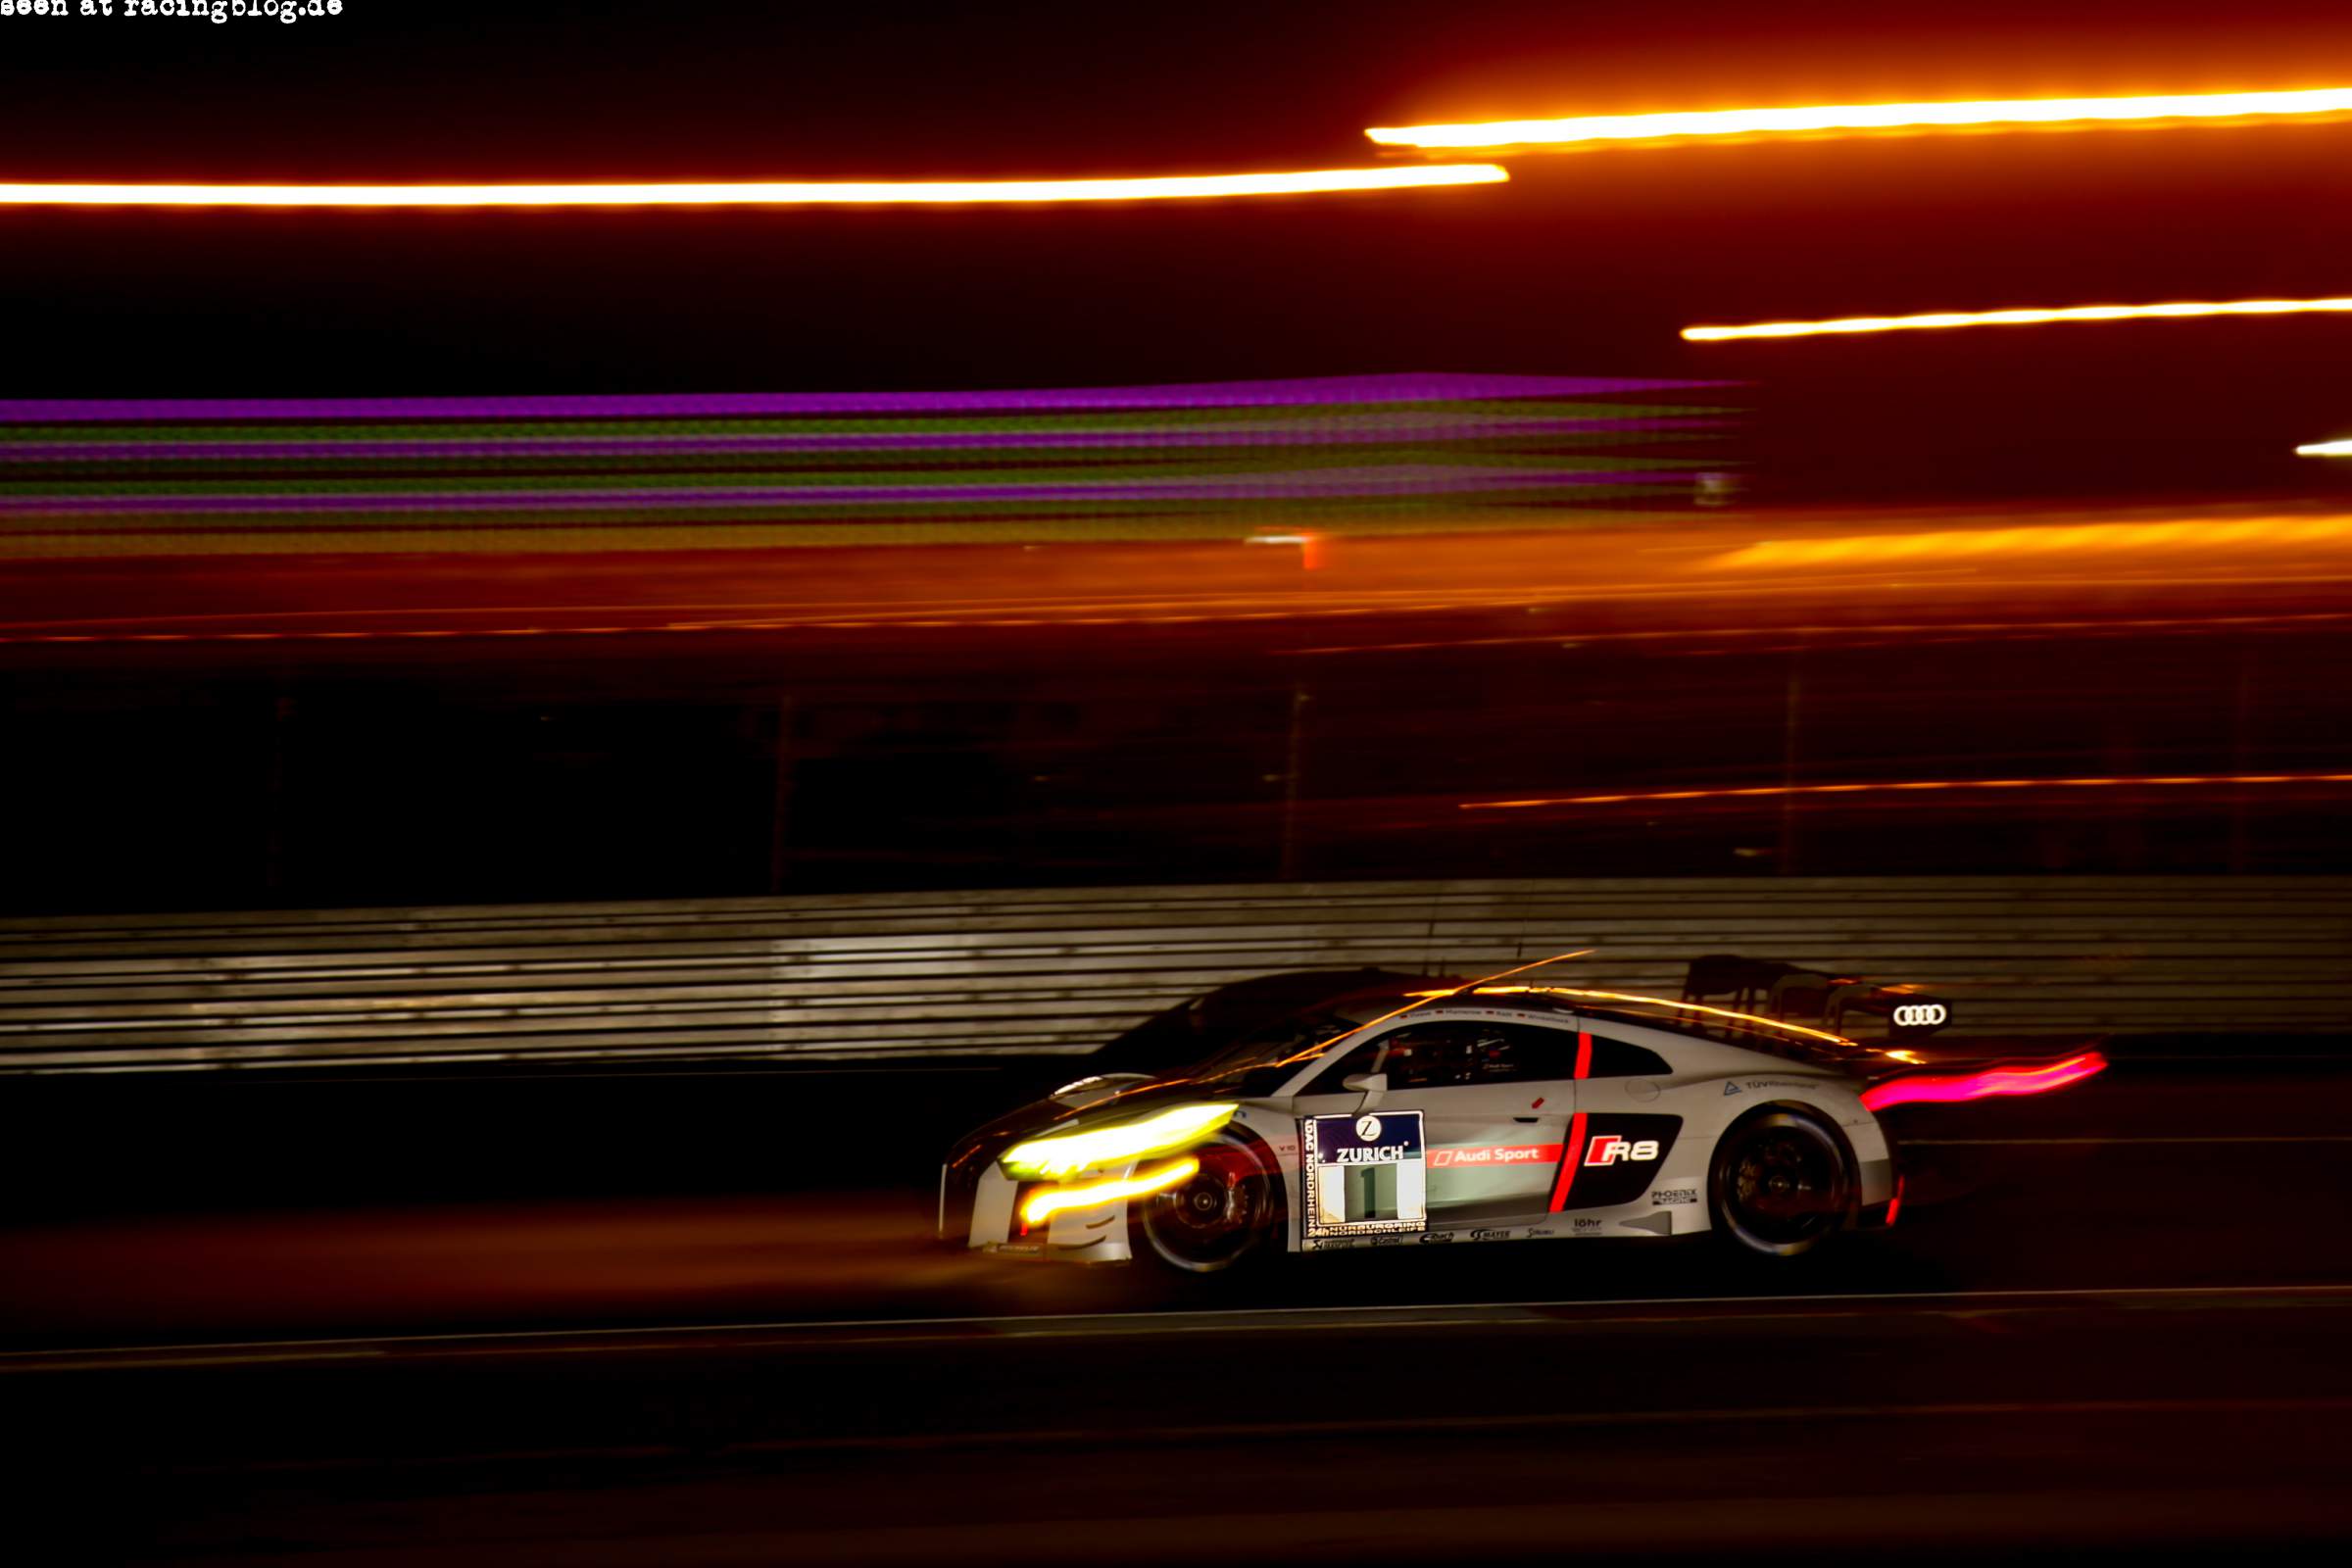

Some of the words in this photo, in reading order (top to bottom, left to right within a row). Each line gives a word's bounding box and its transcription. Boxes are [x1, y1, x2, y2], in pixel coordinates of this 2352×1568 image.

[1336, 1145, 1403, 1163] ZURICH
[1454, 1150, 1491, 1162] Audi
[1494, 1148, 1539, 1163] Sport
[1601, 1140, 1659, 1162] R8
[1305, 1153, 1316, 1229] NORDRHEIN
[1360, 1166, 1376, 1218] 1
[1574, 1218, 1602, 1228] löhr
